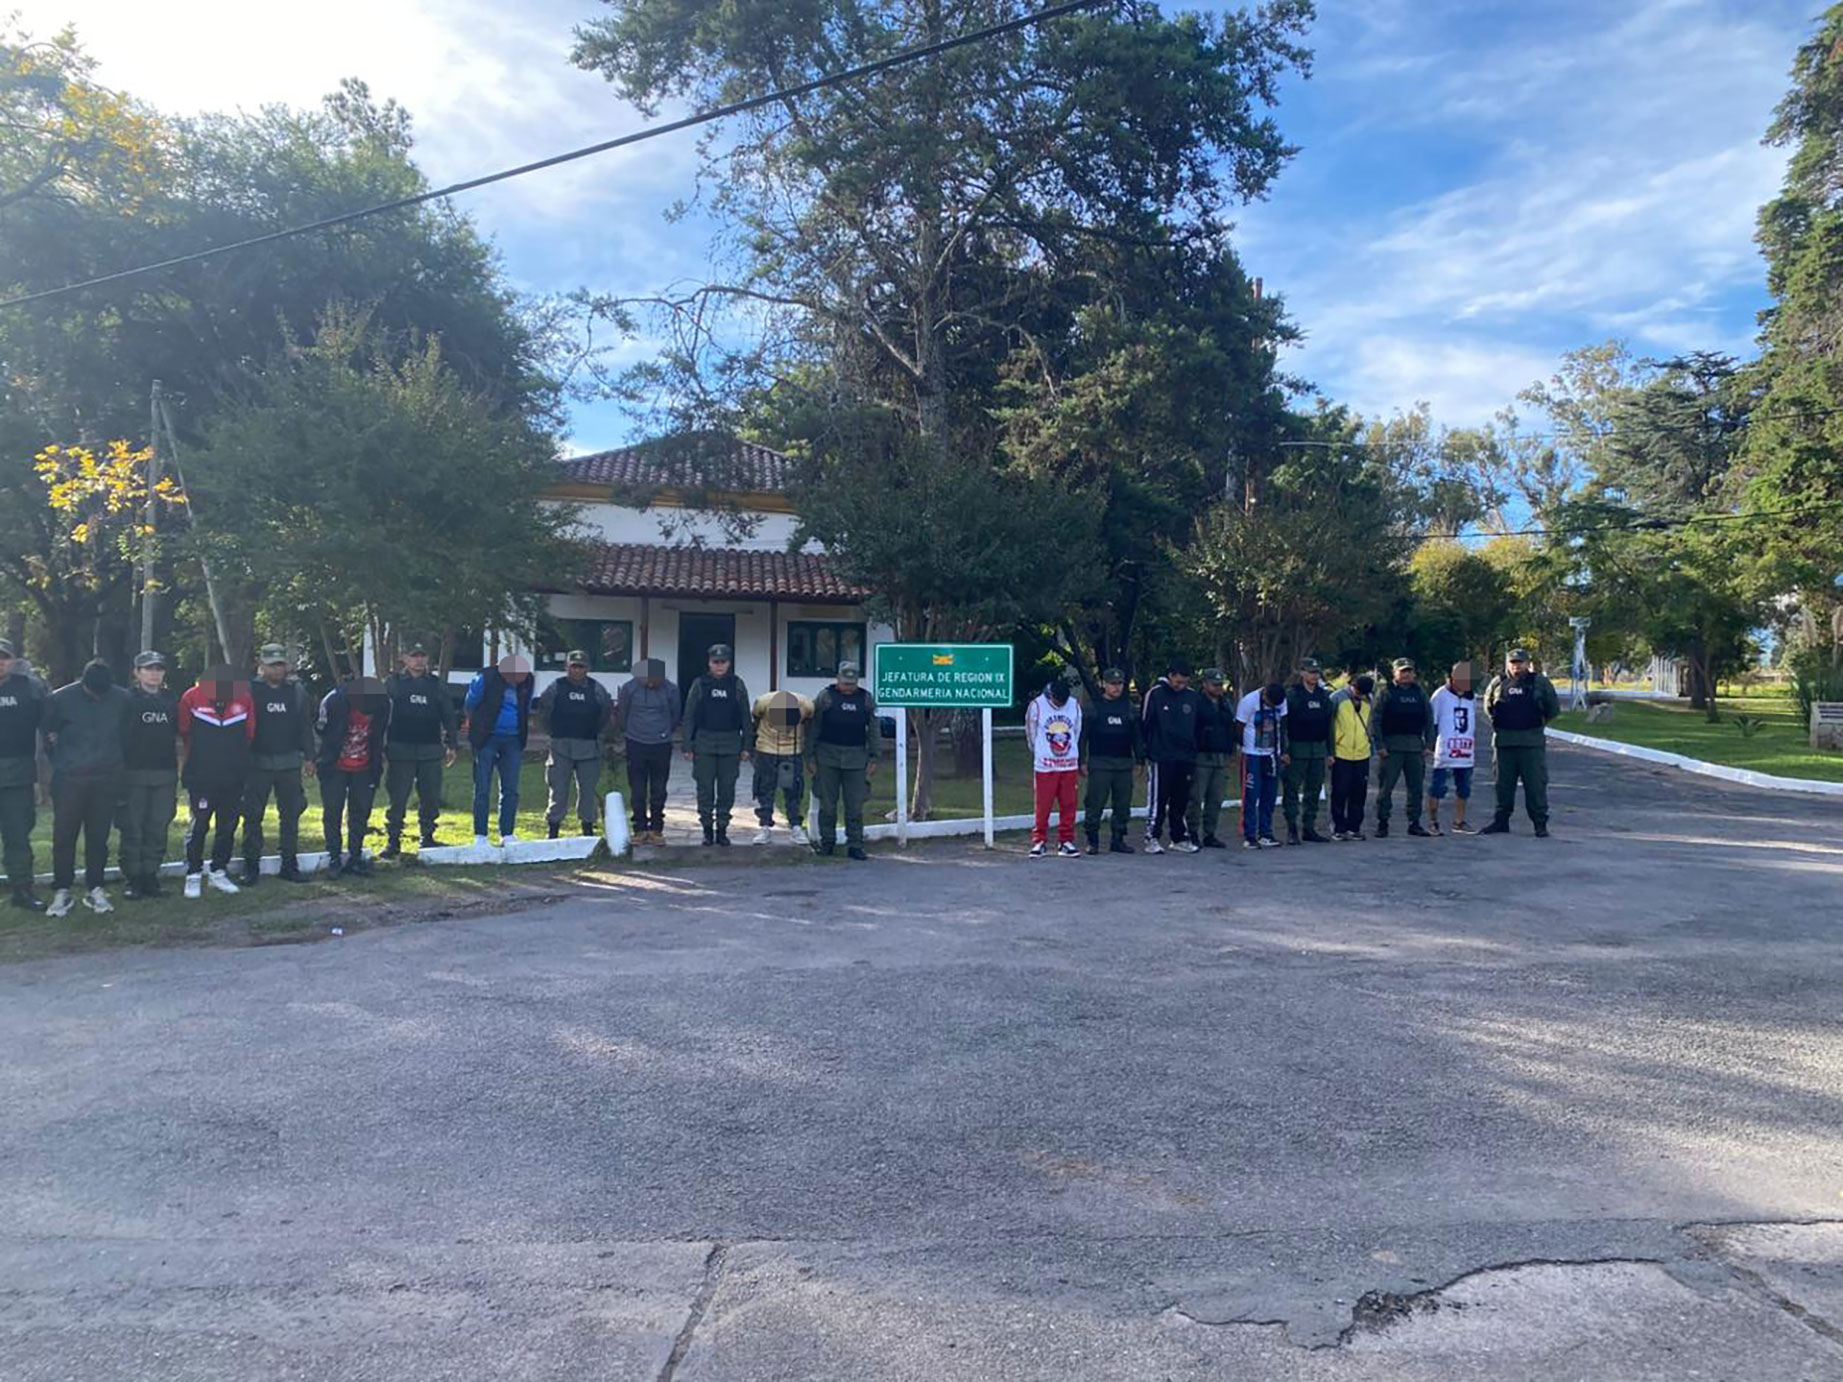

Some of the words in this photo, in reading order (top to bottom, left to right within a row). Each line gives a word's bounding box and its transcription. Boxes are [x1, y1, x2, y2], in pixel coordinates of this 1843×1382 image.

[882, 672, 934, 682] JEFATURA
[938, 672, 951, 682] DE
[954, 672, 992, 683] REGION
[995, 673, 1005, 682] IX
[569, 691, 585, 700] GNA
[712, 689, 727, 698] GNA
[878, 687, 952, 698] GENDARMERIA
[955, 688, 1008, 699] NACIONAL
[410, 694, 427, 704] GNA
[267, 702, 287, 712] GNA
[841, 703, 856, 711] GNA
[142, 711, 167, 723] GNA
[1108, 716, 1122, 725] GNA
